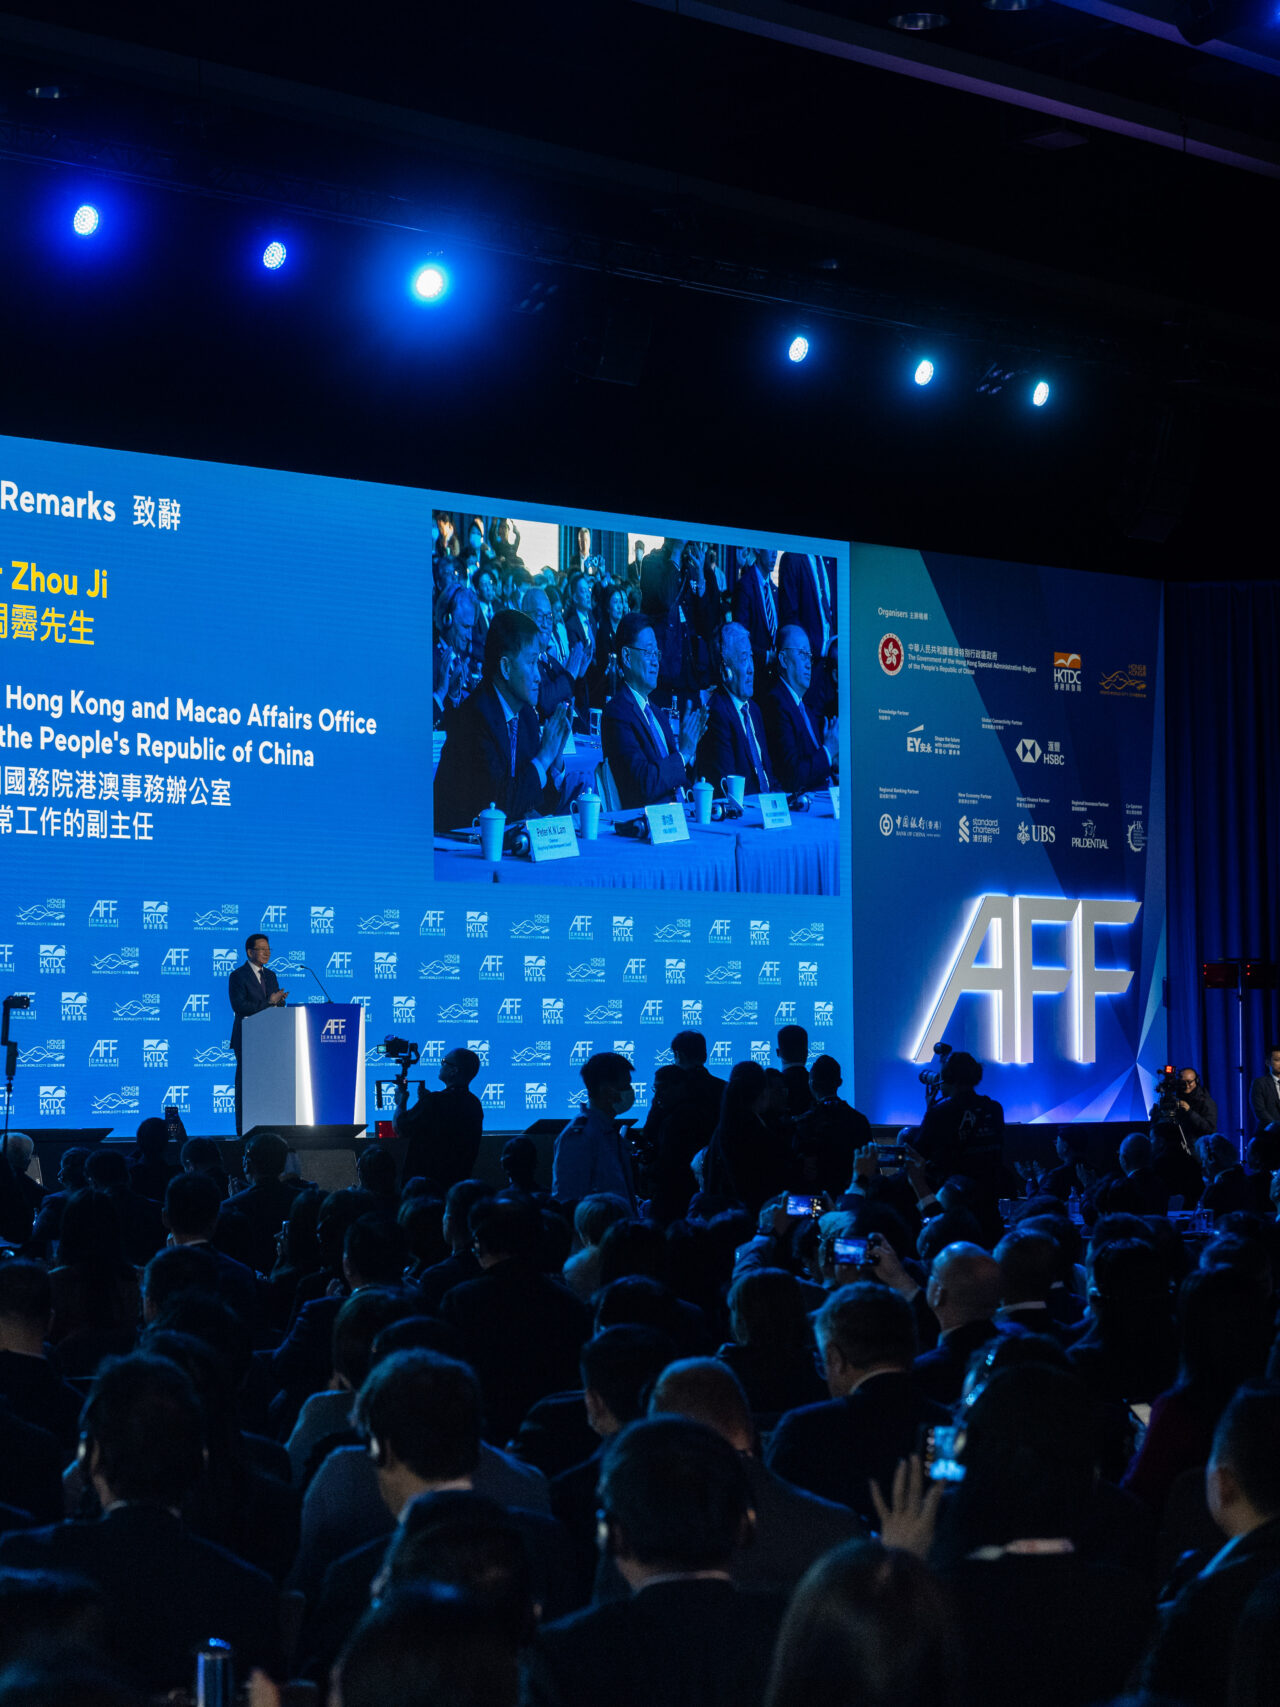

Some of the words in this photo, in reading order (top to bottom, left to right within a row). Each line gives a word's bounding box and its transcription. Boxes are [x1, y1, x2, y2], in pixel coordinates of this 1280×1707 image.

[1, 480, 116, 522] Remarks
[132, 495, 181, 531] 致辭
[11, 561, 78, 595] Zhou
[86, 569, 108, 599] Ji
[878, 607, 908, 618] Organisers
[1054, 668, 1081, 684] HKTDC
[7, 685, 62, 718] Hong
[71, 690, 124, 722] Kong
[132, 697, 168, 719] and
[177, 698, 241, 727] Macao
[248, 704, 312, 731] Affairs
[319, 709, 376, 734] Office
[40, 726, 129, 758] People's
[137, 733, 225, 763] Republic
[233, 740, 252, 762] of
[259, 741, 313, 766] China
[907, 736, 921, 752] EY
[1043, 753, 1065, 766] HSBC
[973, 818, 998, 826] standard
[973, 826, 1000, 834] chartered
[1031, 824, 1056, 843] UBS
[1072, 837, 1109, 849] PRUDENTIAL
[90, 900, 118, 918] AFF
[261, 905, 288, 922] AFF
[143, 912, 168, 924] HKTDC
[311, 917, 334, 929] HKTDC
[420, 910, 445, 927] AFF
[569, 915, 593, 931] AFF
[466, 923, 488, 933] HKTDC
[613, 927, 633, 937] HKTDC
[709, 920, 731, 935] AFF
[750, 931, 769, 940] HKTDC
[40, 957, 65, 968] HKTDC
[163, 948, 189, 966] AFF
[327, 952, 353, 968] AFF
[480, 955, 504, 972] AFF
[374, 964, 397, 974] HKTDC
[524, 967, 546, 977] HKTDC
[623, 958, 647, 973] AFF
[759, 961, 780, 976] AFF
[665, 969, 685, 979] HKTDC
[799, 971, 817, 981] HKTDC
[911, 893, 1142, 1063] AFF
[640, 1000, 664, 1015] AFF
[322, 1019, 346, 1034] AFF
[143, 1050, 169, 1062] HKTDC
